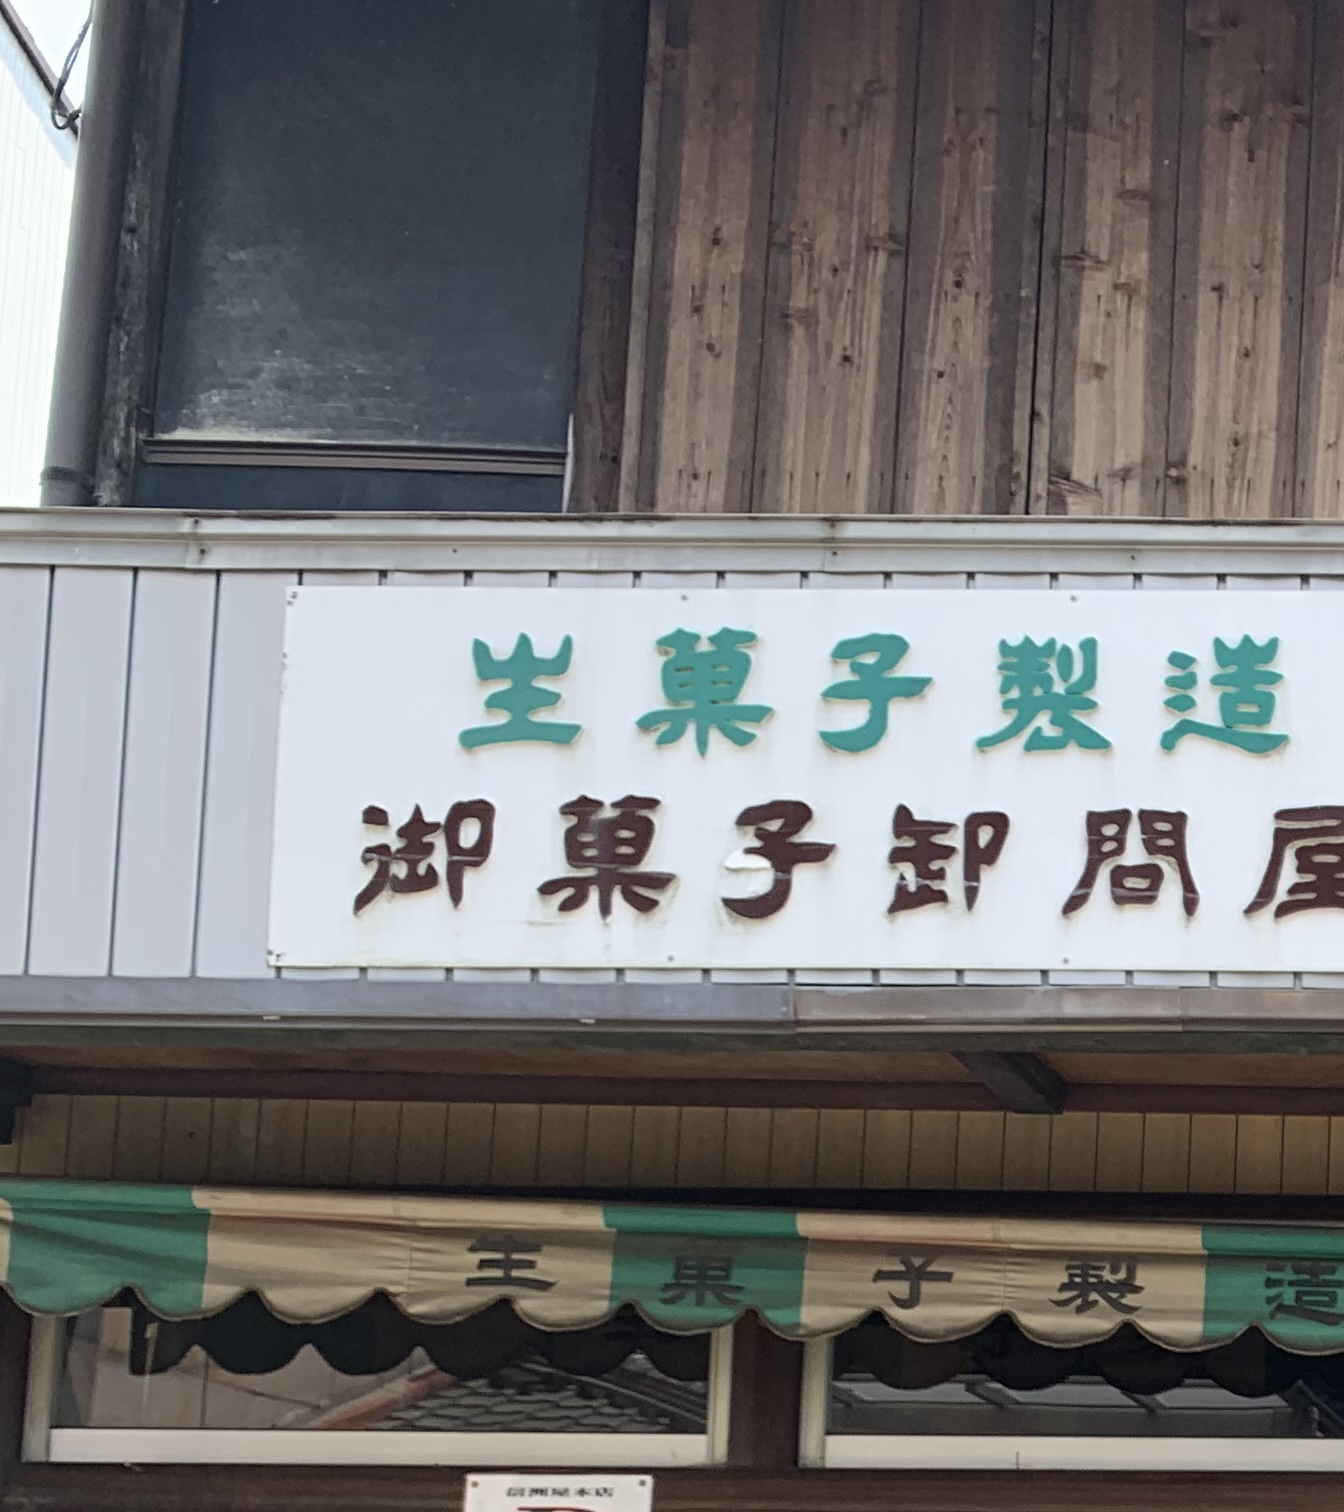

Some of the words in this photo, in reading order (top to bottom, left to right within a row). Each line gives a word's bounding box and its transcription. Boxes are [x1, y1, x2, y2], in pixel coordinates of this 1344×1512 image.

[457, 627, 1292, 758] 生菓子製造
